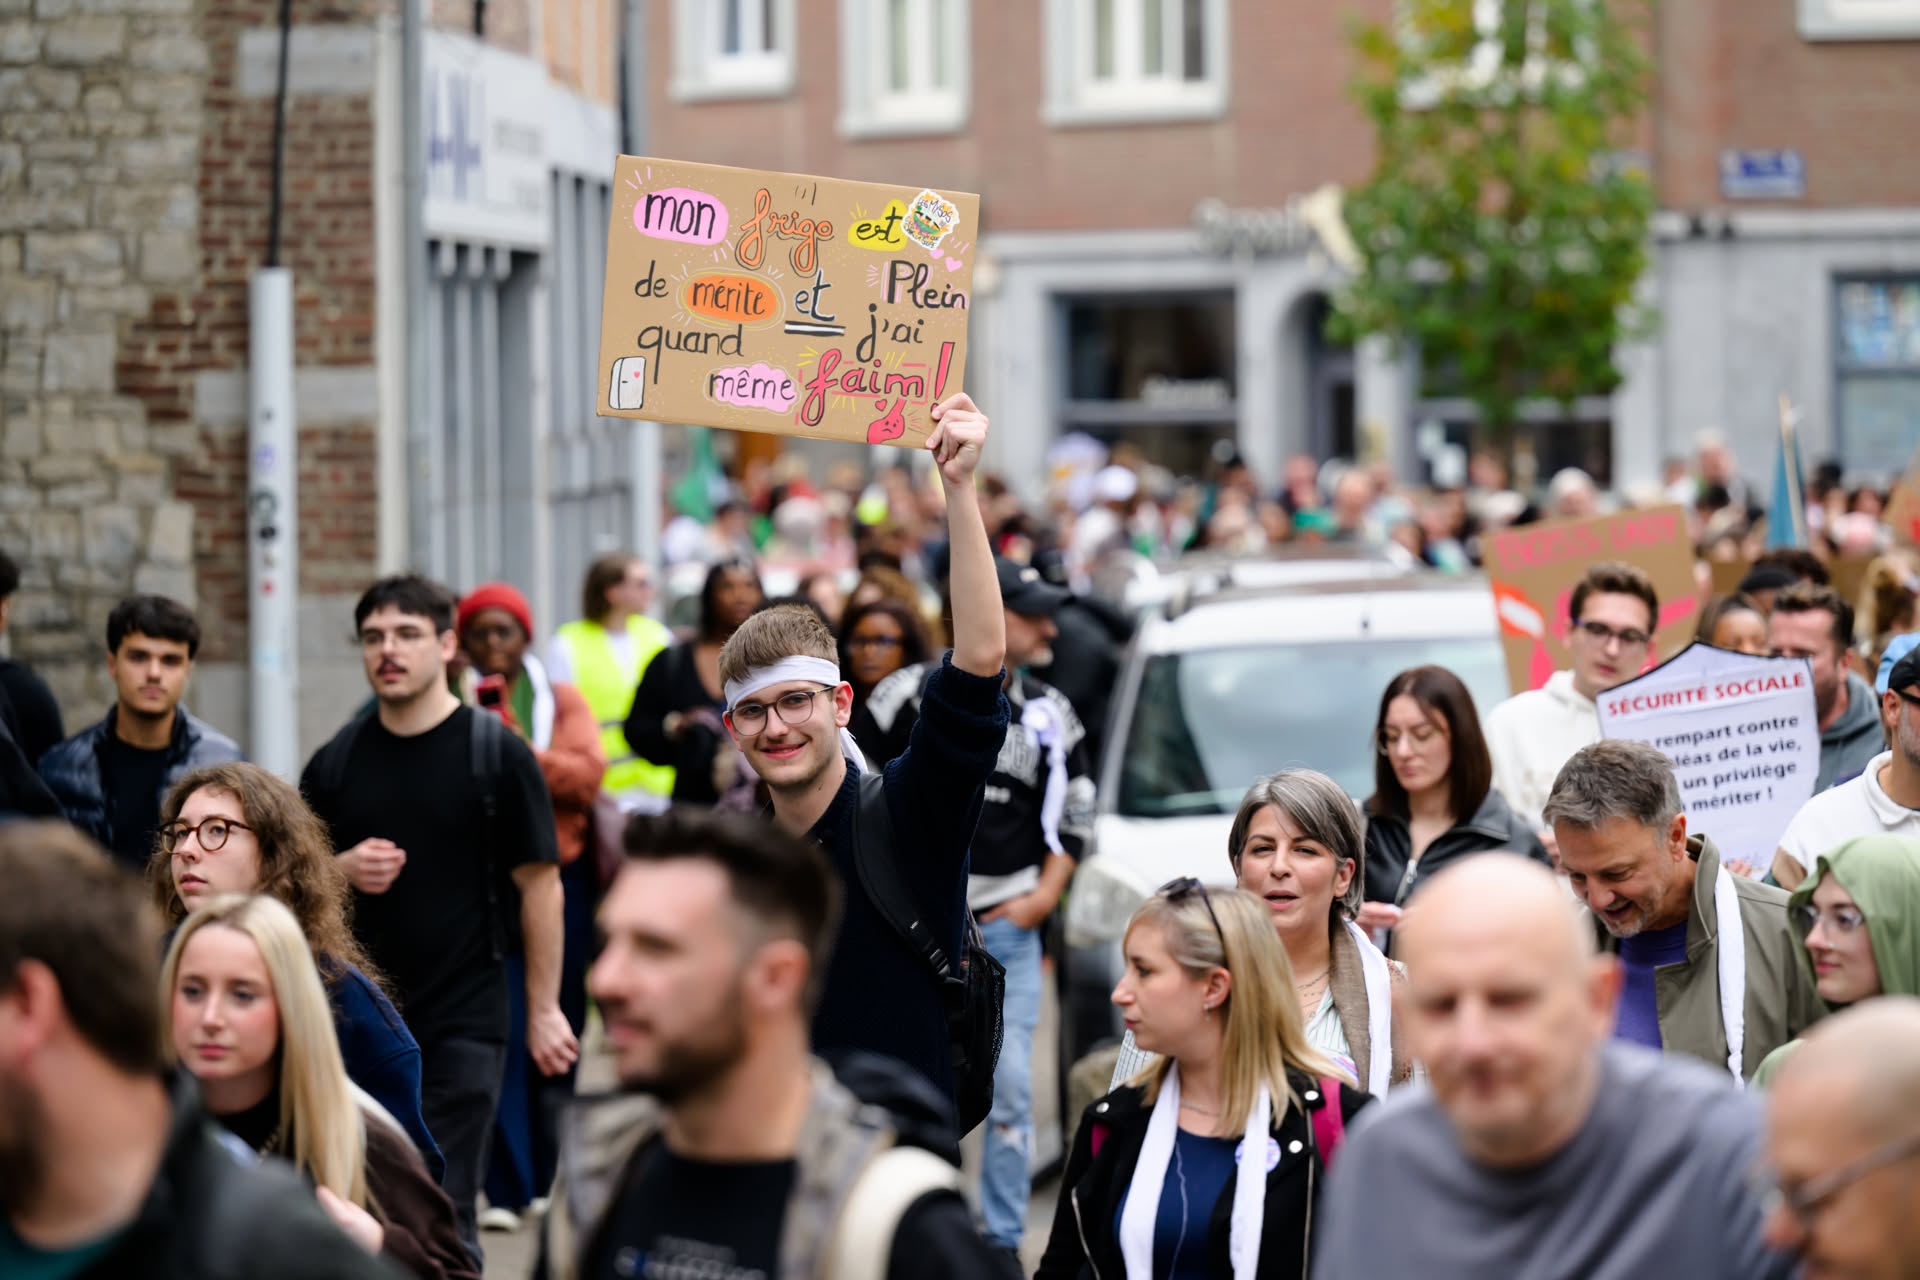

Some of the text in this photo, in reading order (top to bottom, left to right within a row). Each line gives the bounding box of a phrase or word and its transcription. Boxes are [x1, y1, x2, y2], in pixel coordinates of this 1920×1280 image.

[644, 194, 716, 240] mon
[737, 188, 834, 275] frigo
[855, 206, 903, 244] est
[635, 260, 835, 322] de mérite et
[886, 259, 966, 310] Plein
[637, 323, 745, 385] quand
[856, 303, 923, 363] j'ai
[708, 369, 796, 400] même
[1608, 672, 1806, 717] SÉCURITÉ SOCIALE
[1655, 715, 1799, 748] rempart contre
[1673, 739, 1802, 767] léas de la vie,
[1683, 762, 1798, 791] un privilège
[1692, 788, 1761, 812] mériter
